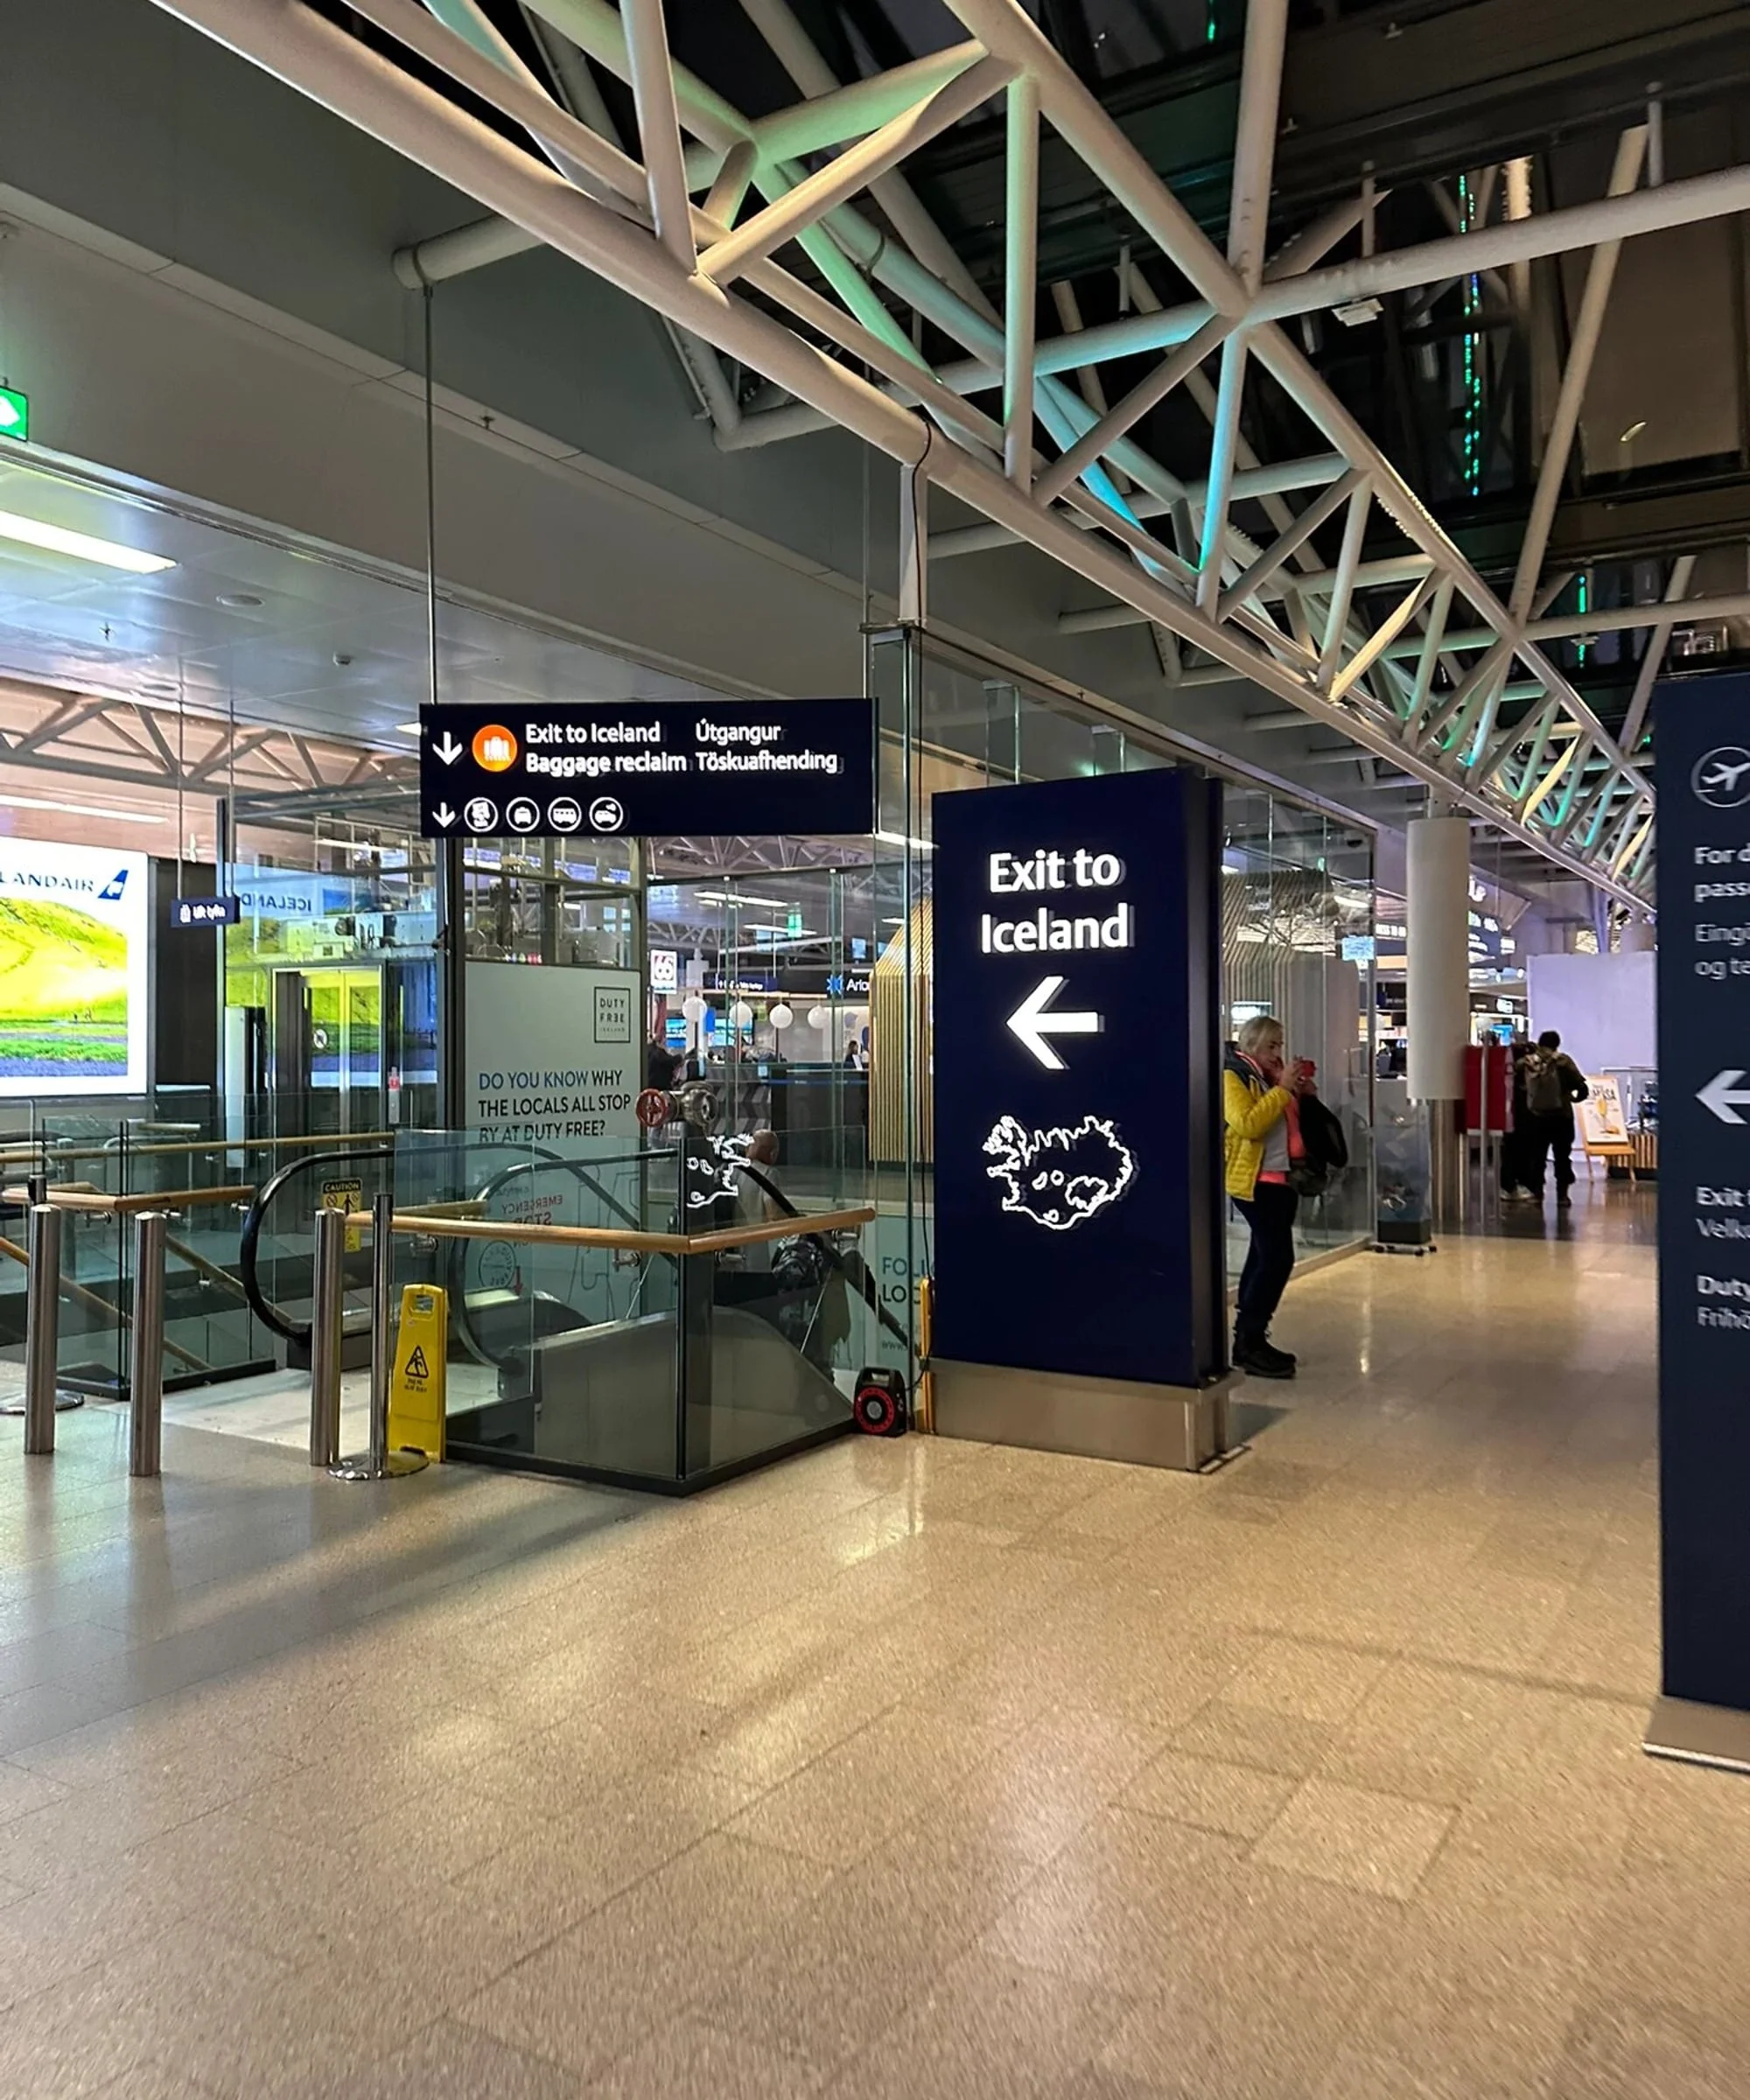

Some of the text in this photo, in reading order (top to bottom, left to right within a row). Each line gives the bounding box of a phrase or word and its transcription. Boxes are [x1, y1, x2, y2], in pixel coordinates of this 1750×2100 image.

[526, 722, 660, 743] Exit to Iceland
[696, 718, 780, 745] Útgangur
[526, 752, 687, 777] Baggage reclaim
[696, 750, 837, 774] Töskuafhending
[1695, 846, 1736, 864] For
[990, 848, 1122, 892] Exit to
[1695, 882, 1750, 902] pass
[982, 902, 1129, 953] Iceland
[1694, 962, 1727, 980] og
[600, 998, 625, 1008] DUTY
[600, 1012, 624, 1023] FREE
[480, 1069, 623, 1090] DO YOU KNOW WHY
[479, 1094, 631, 1117] THE LOCALS ALL STOP
[501, 1125, 521, 1143] AT
[525, 1123, 562, 1141] DUTY
[566, 1120, 606, 1137] FREE?
[325, 1181, 360, 1192] CAUTION
[1697, 1186, 1745, 1207] Exit
[1697, 1275, 1750, 1302] Duty
